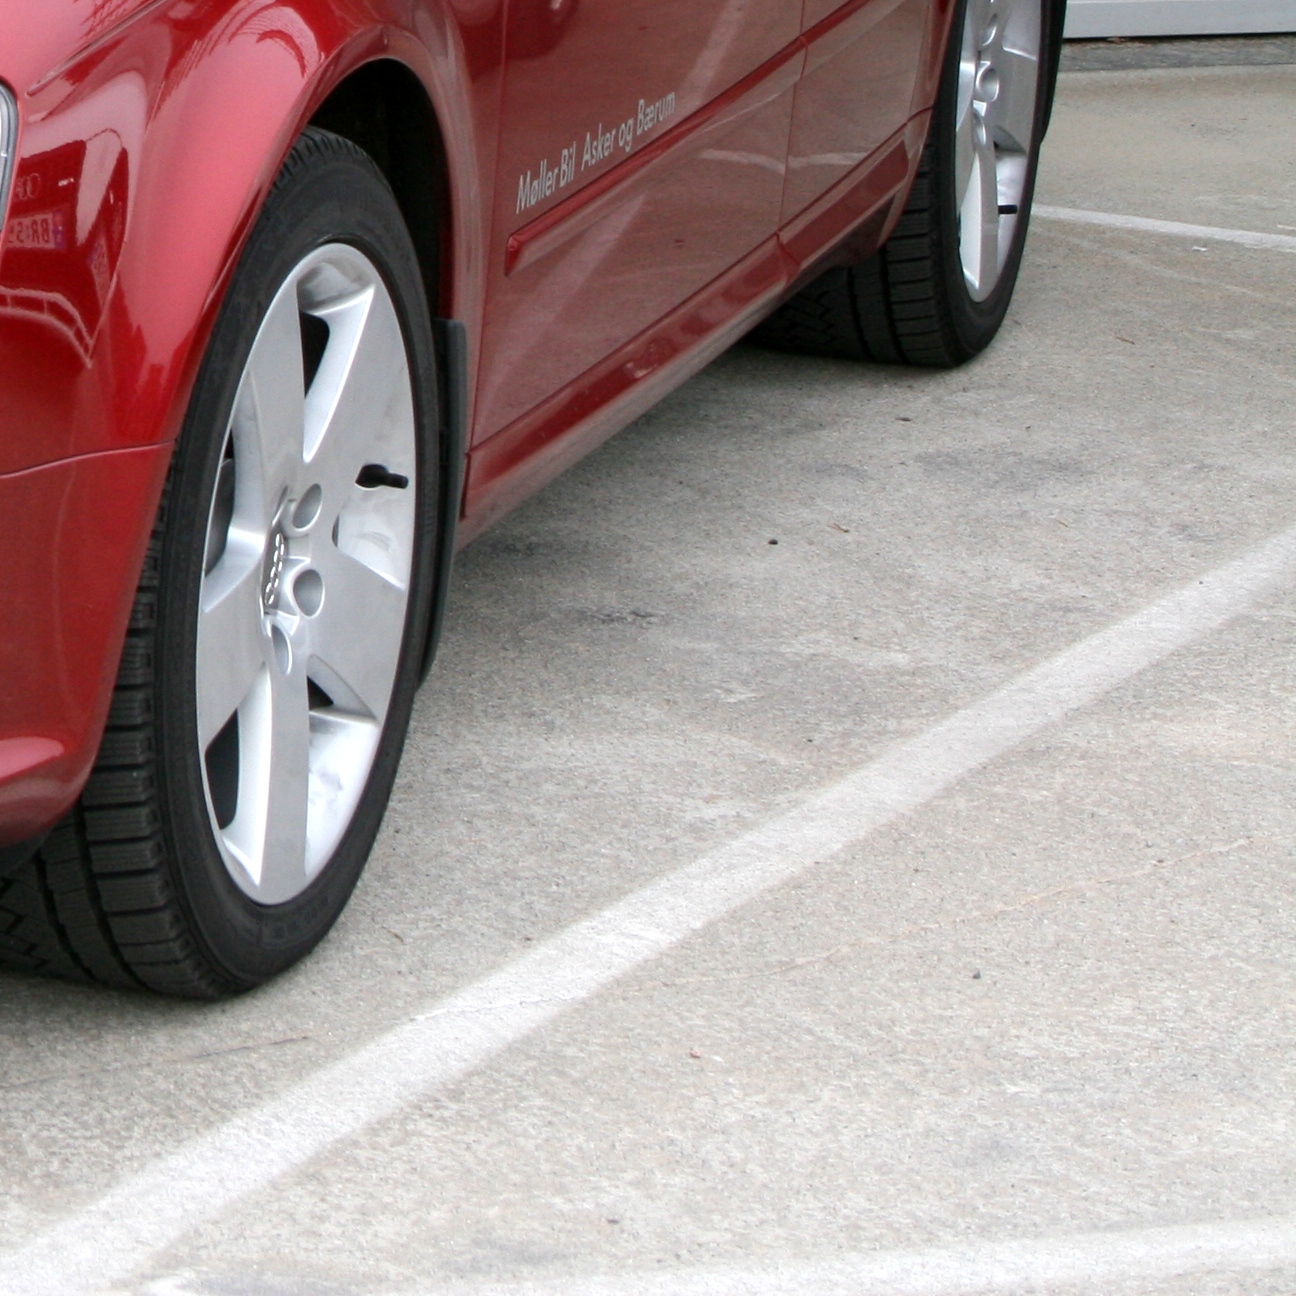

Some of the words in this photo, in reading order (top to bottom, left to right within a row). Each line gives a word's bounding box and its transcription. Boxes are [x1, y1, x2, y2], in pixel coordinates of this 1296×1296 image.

[515, 159, 559, 214] Møller
[559, 141, 576, 188] Bil
[581, 122, 616, 172] Asker
[618, 117, 634, 152] og
[636, 91, 676, 136] Bærum
